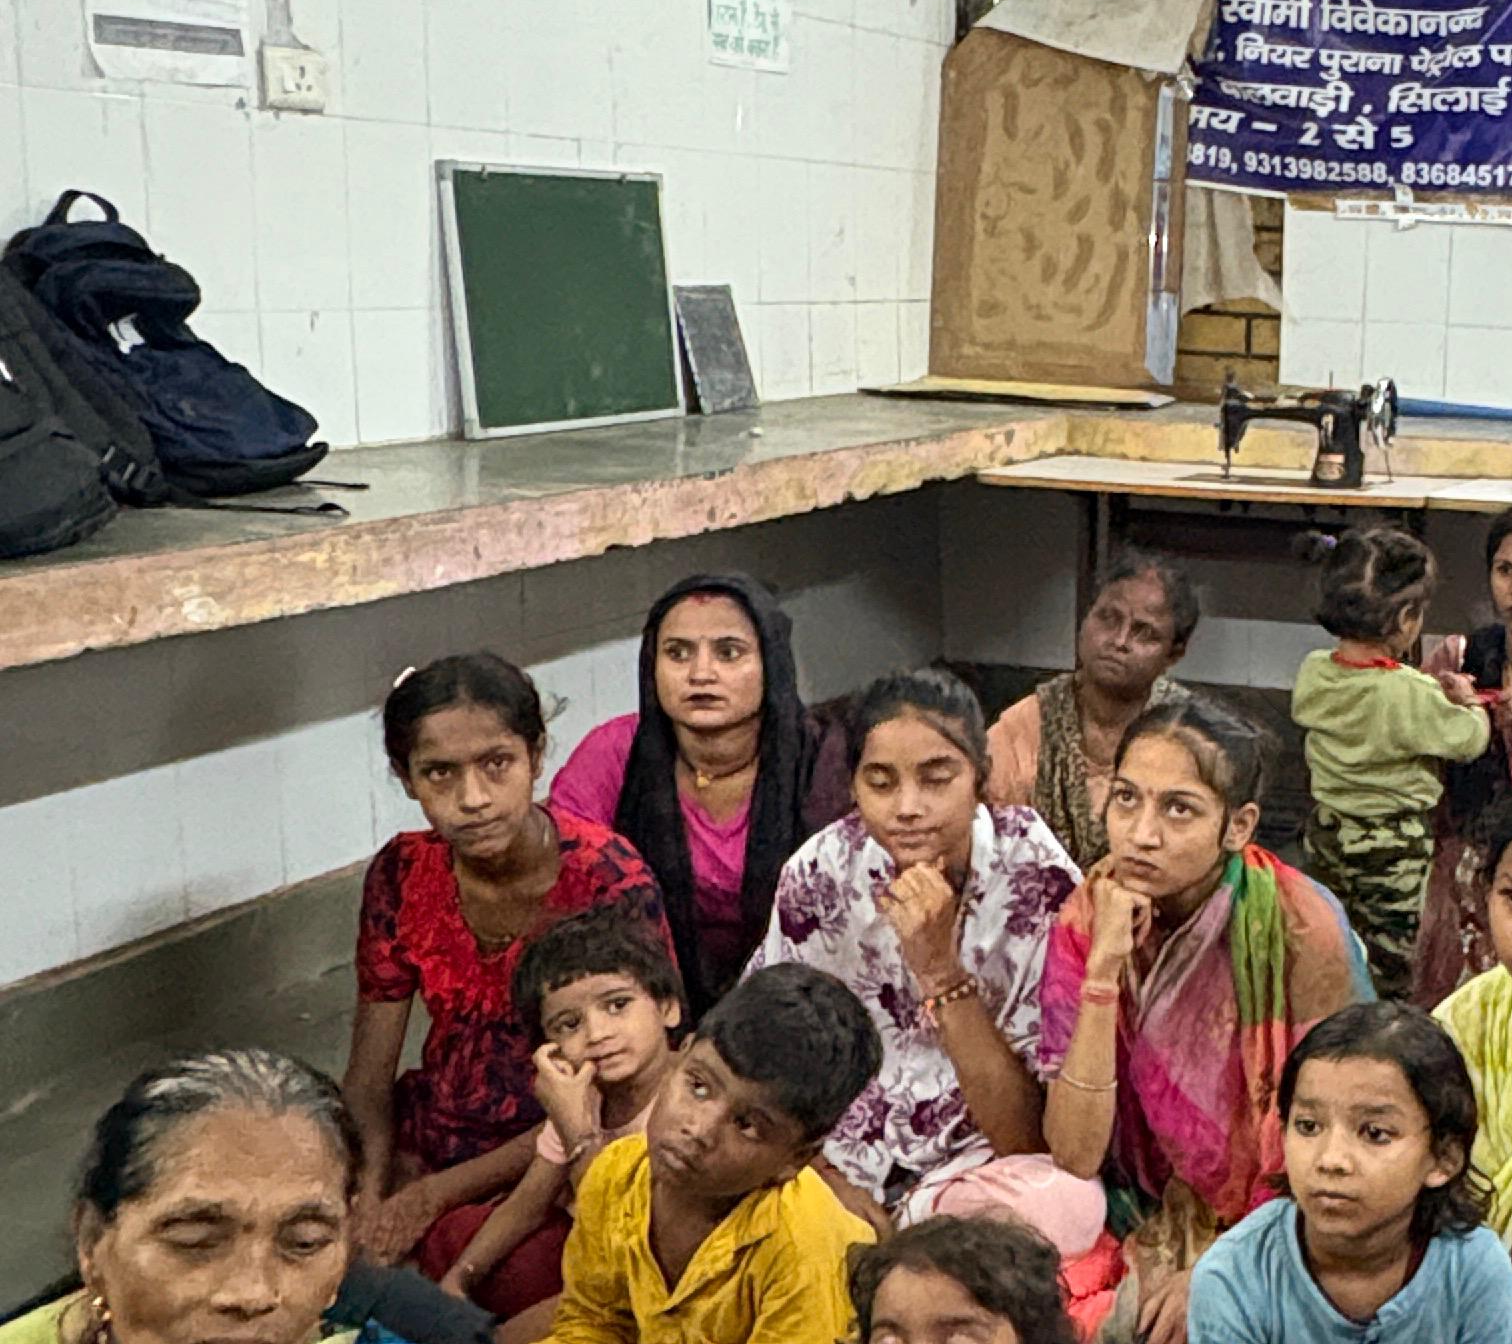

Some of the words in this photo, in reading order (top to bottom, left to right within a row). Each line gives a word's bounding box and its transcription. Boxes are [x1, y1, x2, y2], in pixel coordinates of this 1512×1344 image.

[1235, 32, 1316, 69] नियर
[1318, 49, 1403, 81] पुराना
[1387, 75, 1512, 116] सिलाई
[1297, 121, 1322, 147] 2
[1331, 115, 1379, 150] से
[1389, 125, 1415, 148] 5
